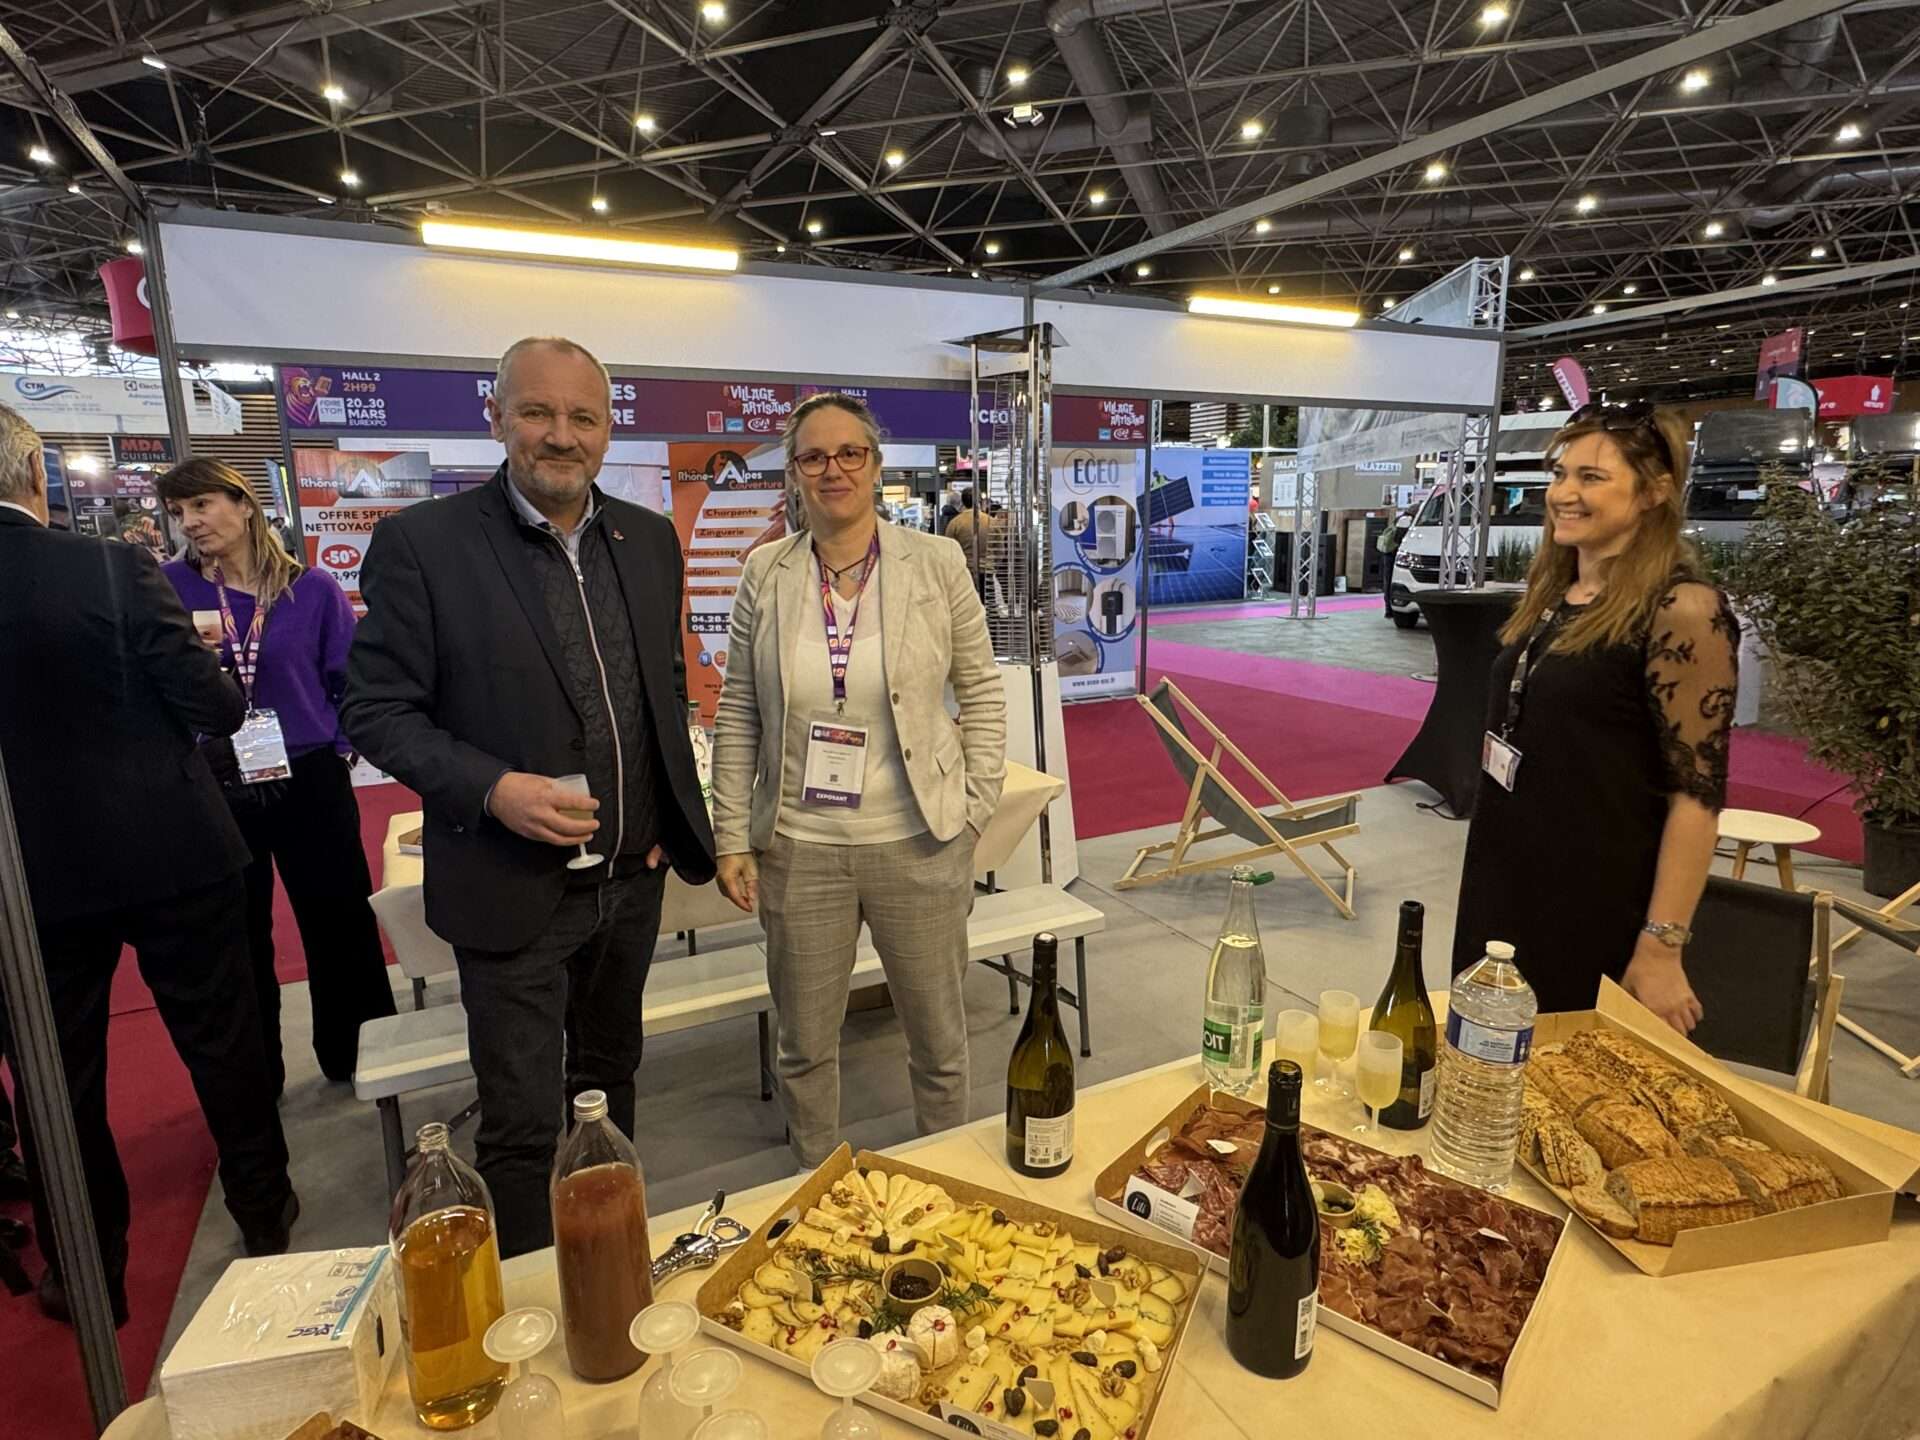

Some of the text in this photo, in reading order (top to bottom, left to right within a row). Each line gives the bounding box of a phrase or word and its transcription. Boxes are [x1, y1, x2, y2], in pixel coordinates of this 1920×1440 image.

[342, 372, 381, 381] HALL 2
[25, 382, 46, 390] CTM
[343, 383, 376, 392] 2H99
[730, 385, 776, 401] VILLAGE
[742, 401, 791, 416] ARTISANS
[347, 409, 386, 419] MARS
[120, 439, 164, 452] MDA
[121, 452, 168, 460] CUISINE
[1073, 458, 1120, 485] ECEO
[729, 480, 783, 489] Couverture
[318, 511, 358, 520] OFFRE
[706, 508, 758, 517] Charpente
[700, 528, 744, 537] Zinguerie
[816, 793, 848, 801] EXPOSANT
